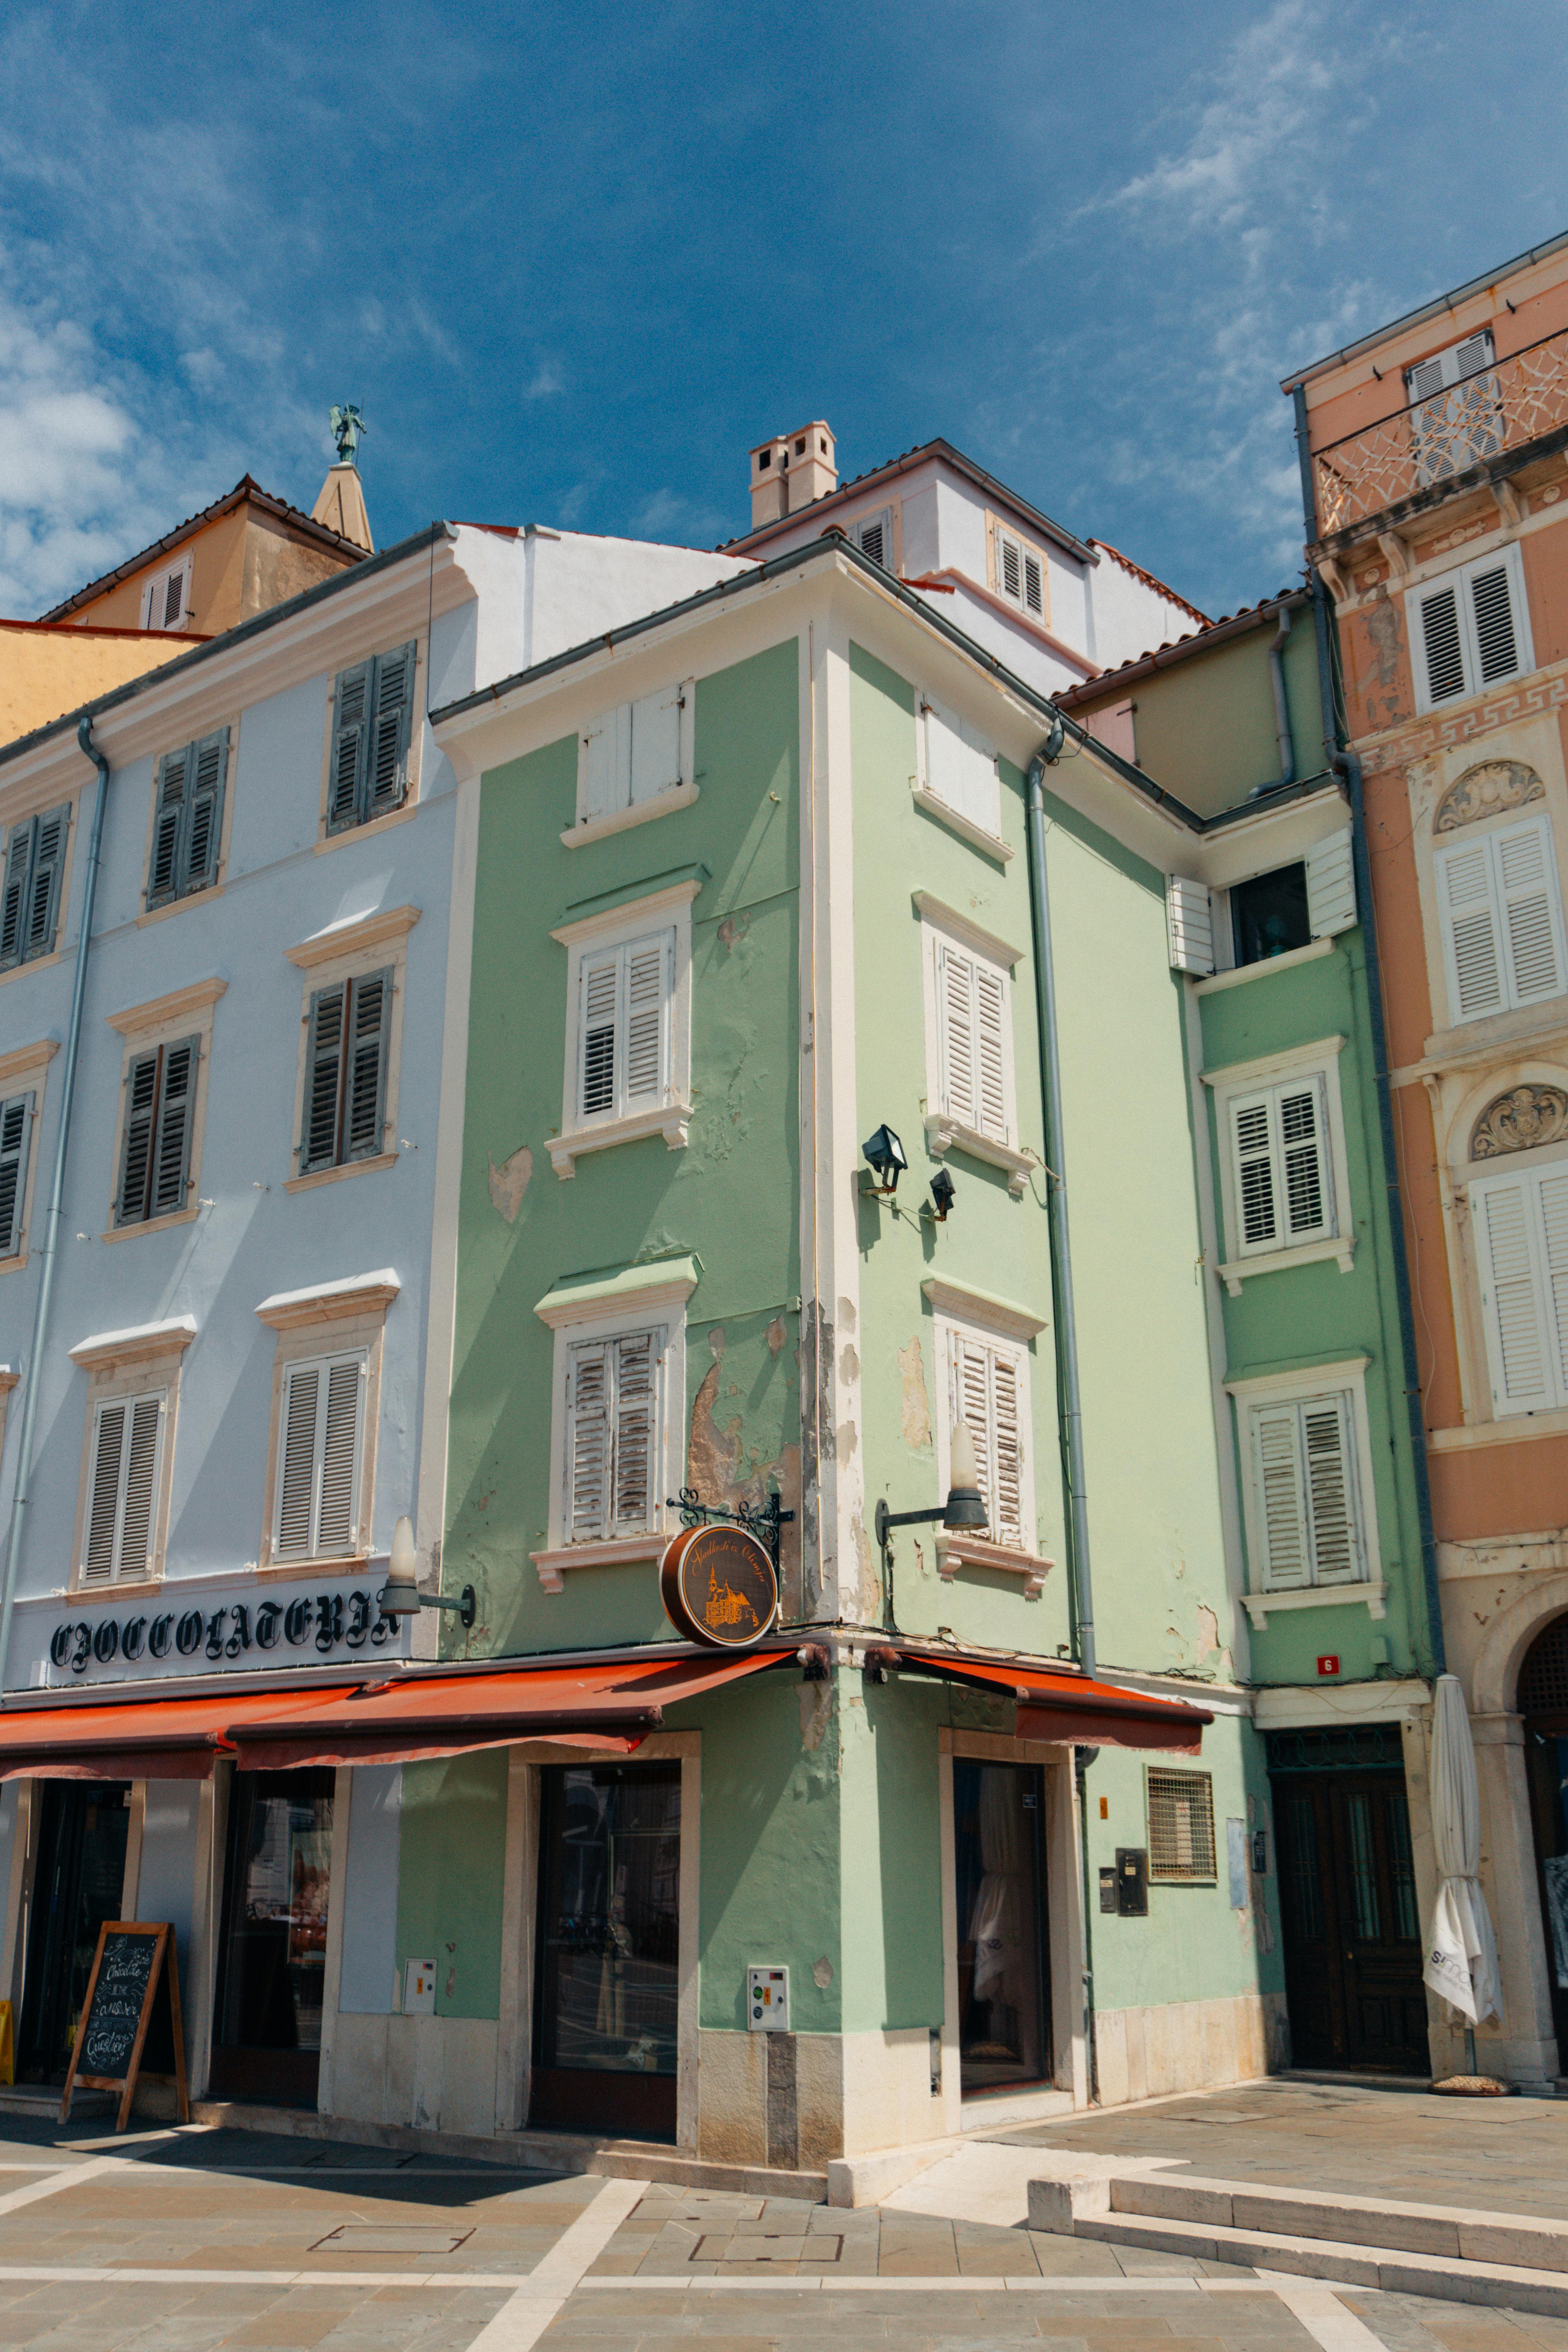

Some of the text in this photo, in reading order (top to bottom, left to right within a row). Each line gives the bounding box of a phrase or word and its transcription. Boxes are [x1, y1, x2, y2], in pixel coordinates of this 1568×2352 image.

[1325, 1660, 1332, 1671] 6
[107, 1960, 142, 1981] Chocolate
[100, 2001, 137, 2016] answer
[87, 2031, 126, 2058] Question
